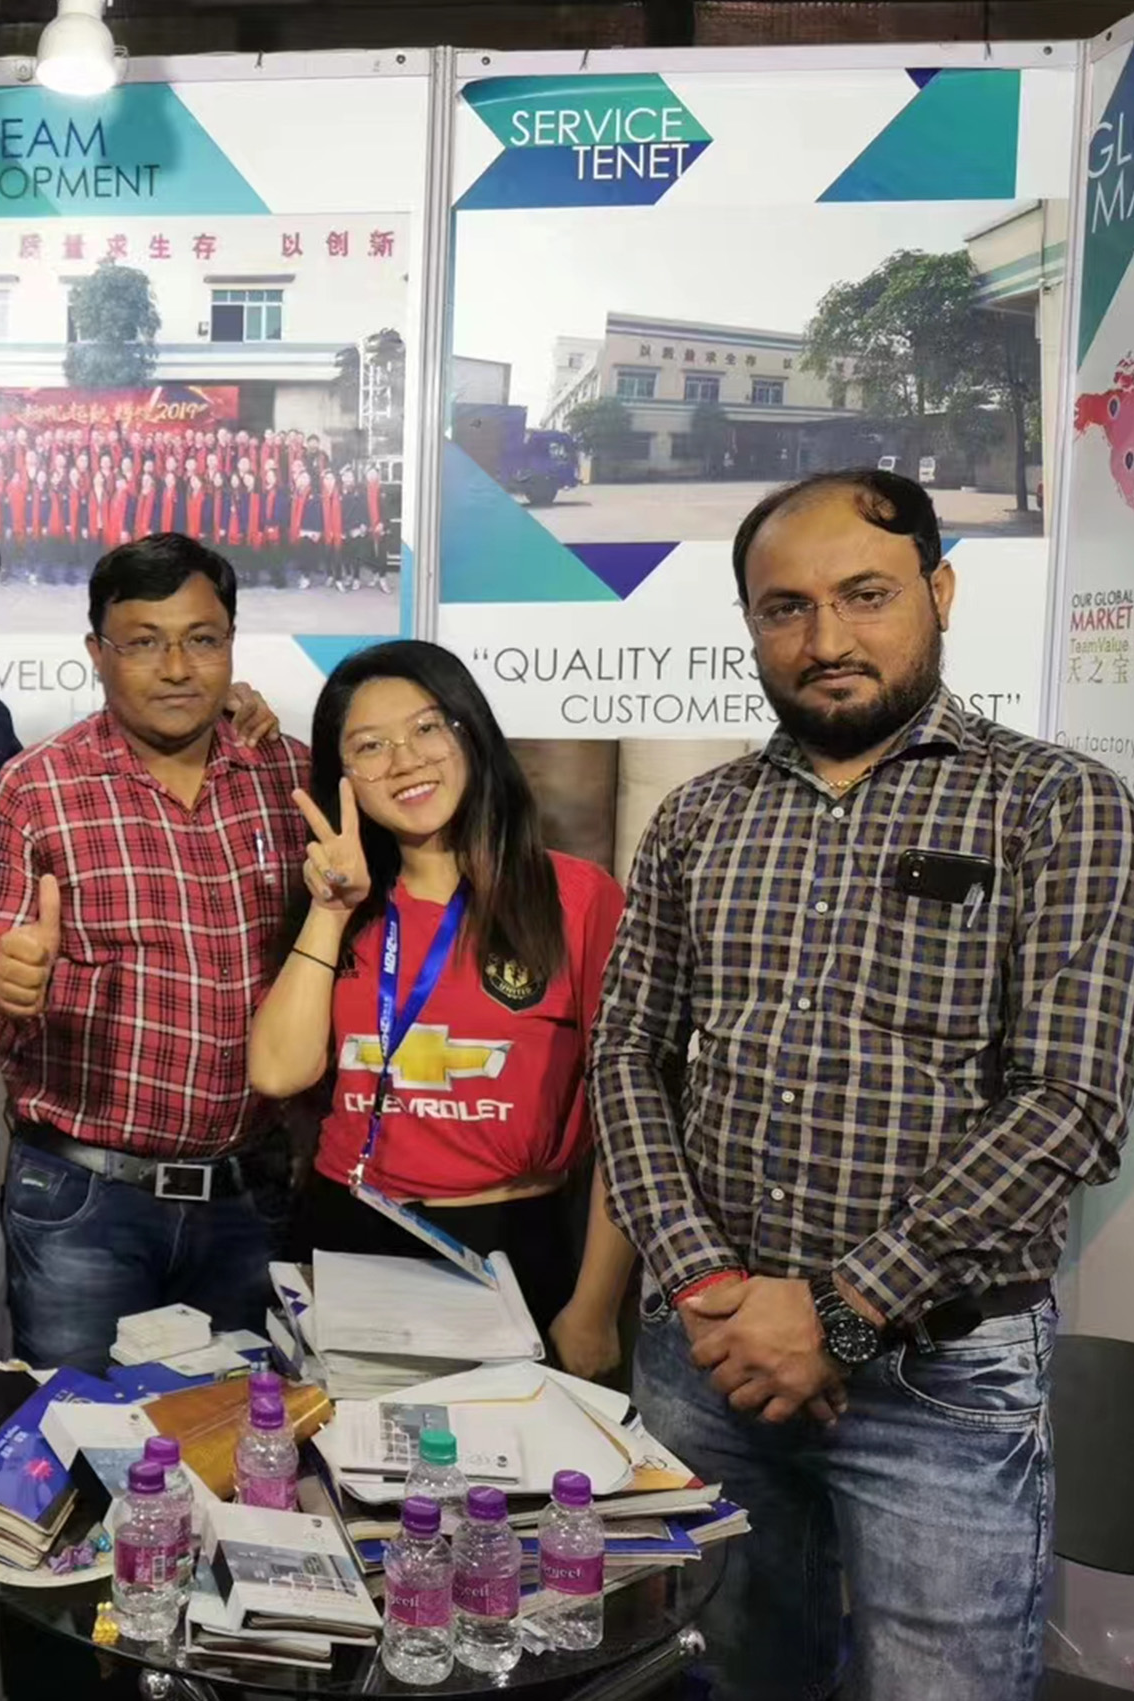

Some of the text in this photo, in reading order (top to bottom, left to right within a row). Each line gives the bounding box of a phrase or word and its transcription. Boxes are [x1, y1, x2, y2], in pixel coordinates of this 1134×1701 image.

[510, 107, 683, 146] SERVICE
[572, 143, 691, 181] TENET
[1071, 589, 1134, 608] OUR GLOBAL
[1070, 605, 1133, 632] MARKET
[1067, 654, 1130, 684] 天之宝
[344, 1093, 514, 1121] CHEVROLET
